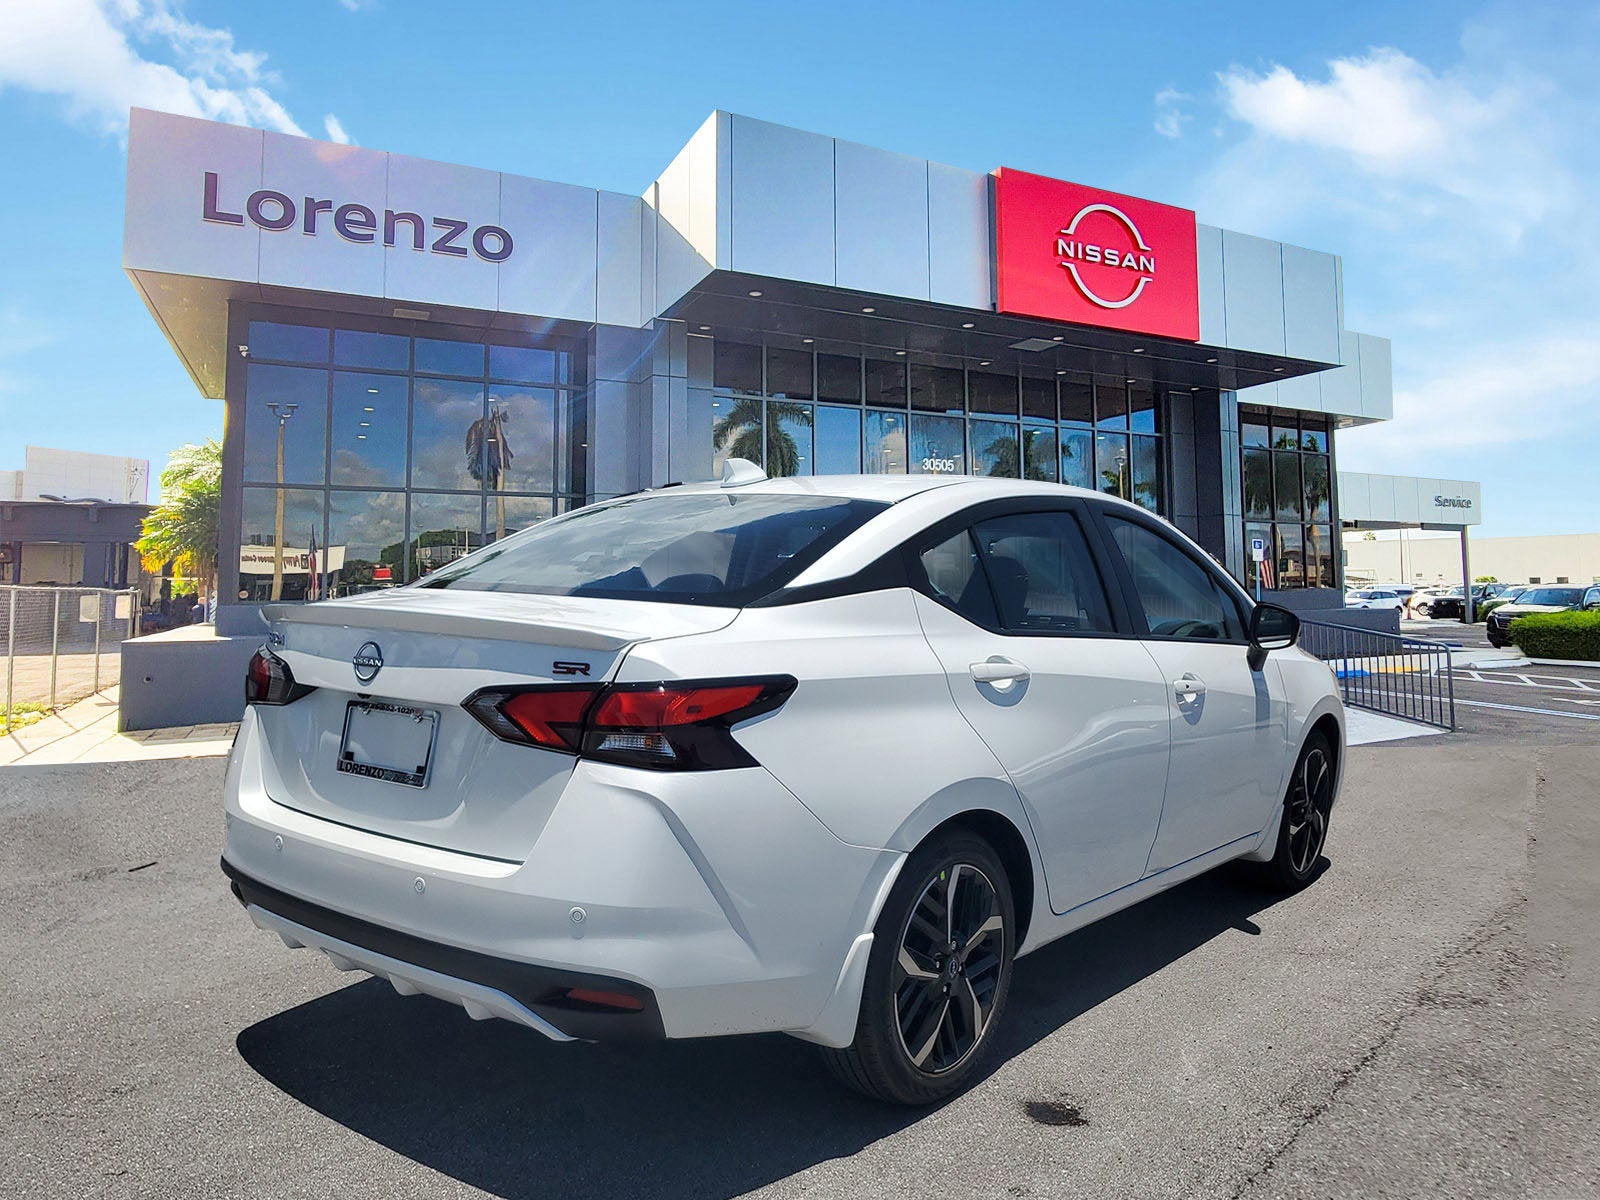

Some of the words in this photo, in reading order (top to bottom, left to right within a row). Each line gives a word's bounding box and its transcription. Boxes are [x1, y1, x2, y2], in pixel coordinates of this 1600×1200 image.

[202, 171, 515, 262] Lorenzo
[1057, 238, 1155, 273] NISSAN
[922, 457, 955, 472] 30505
[1434, 495, 1472, 508] Service
[552, 661, 591, 676] SR
[339, 761, 385, 779] LORENZO
